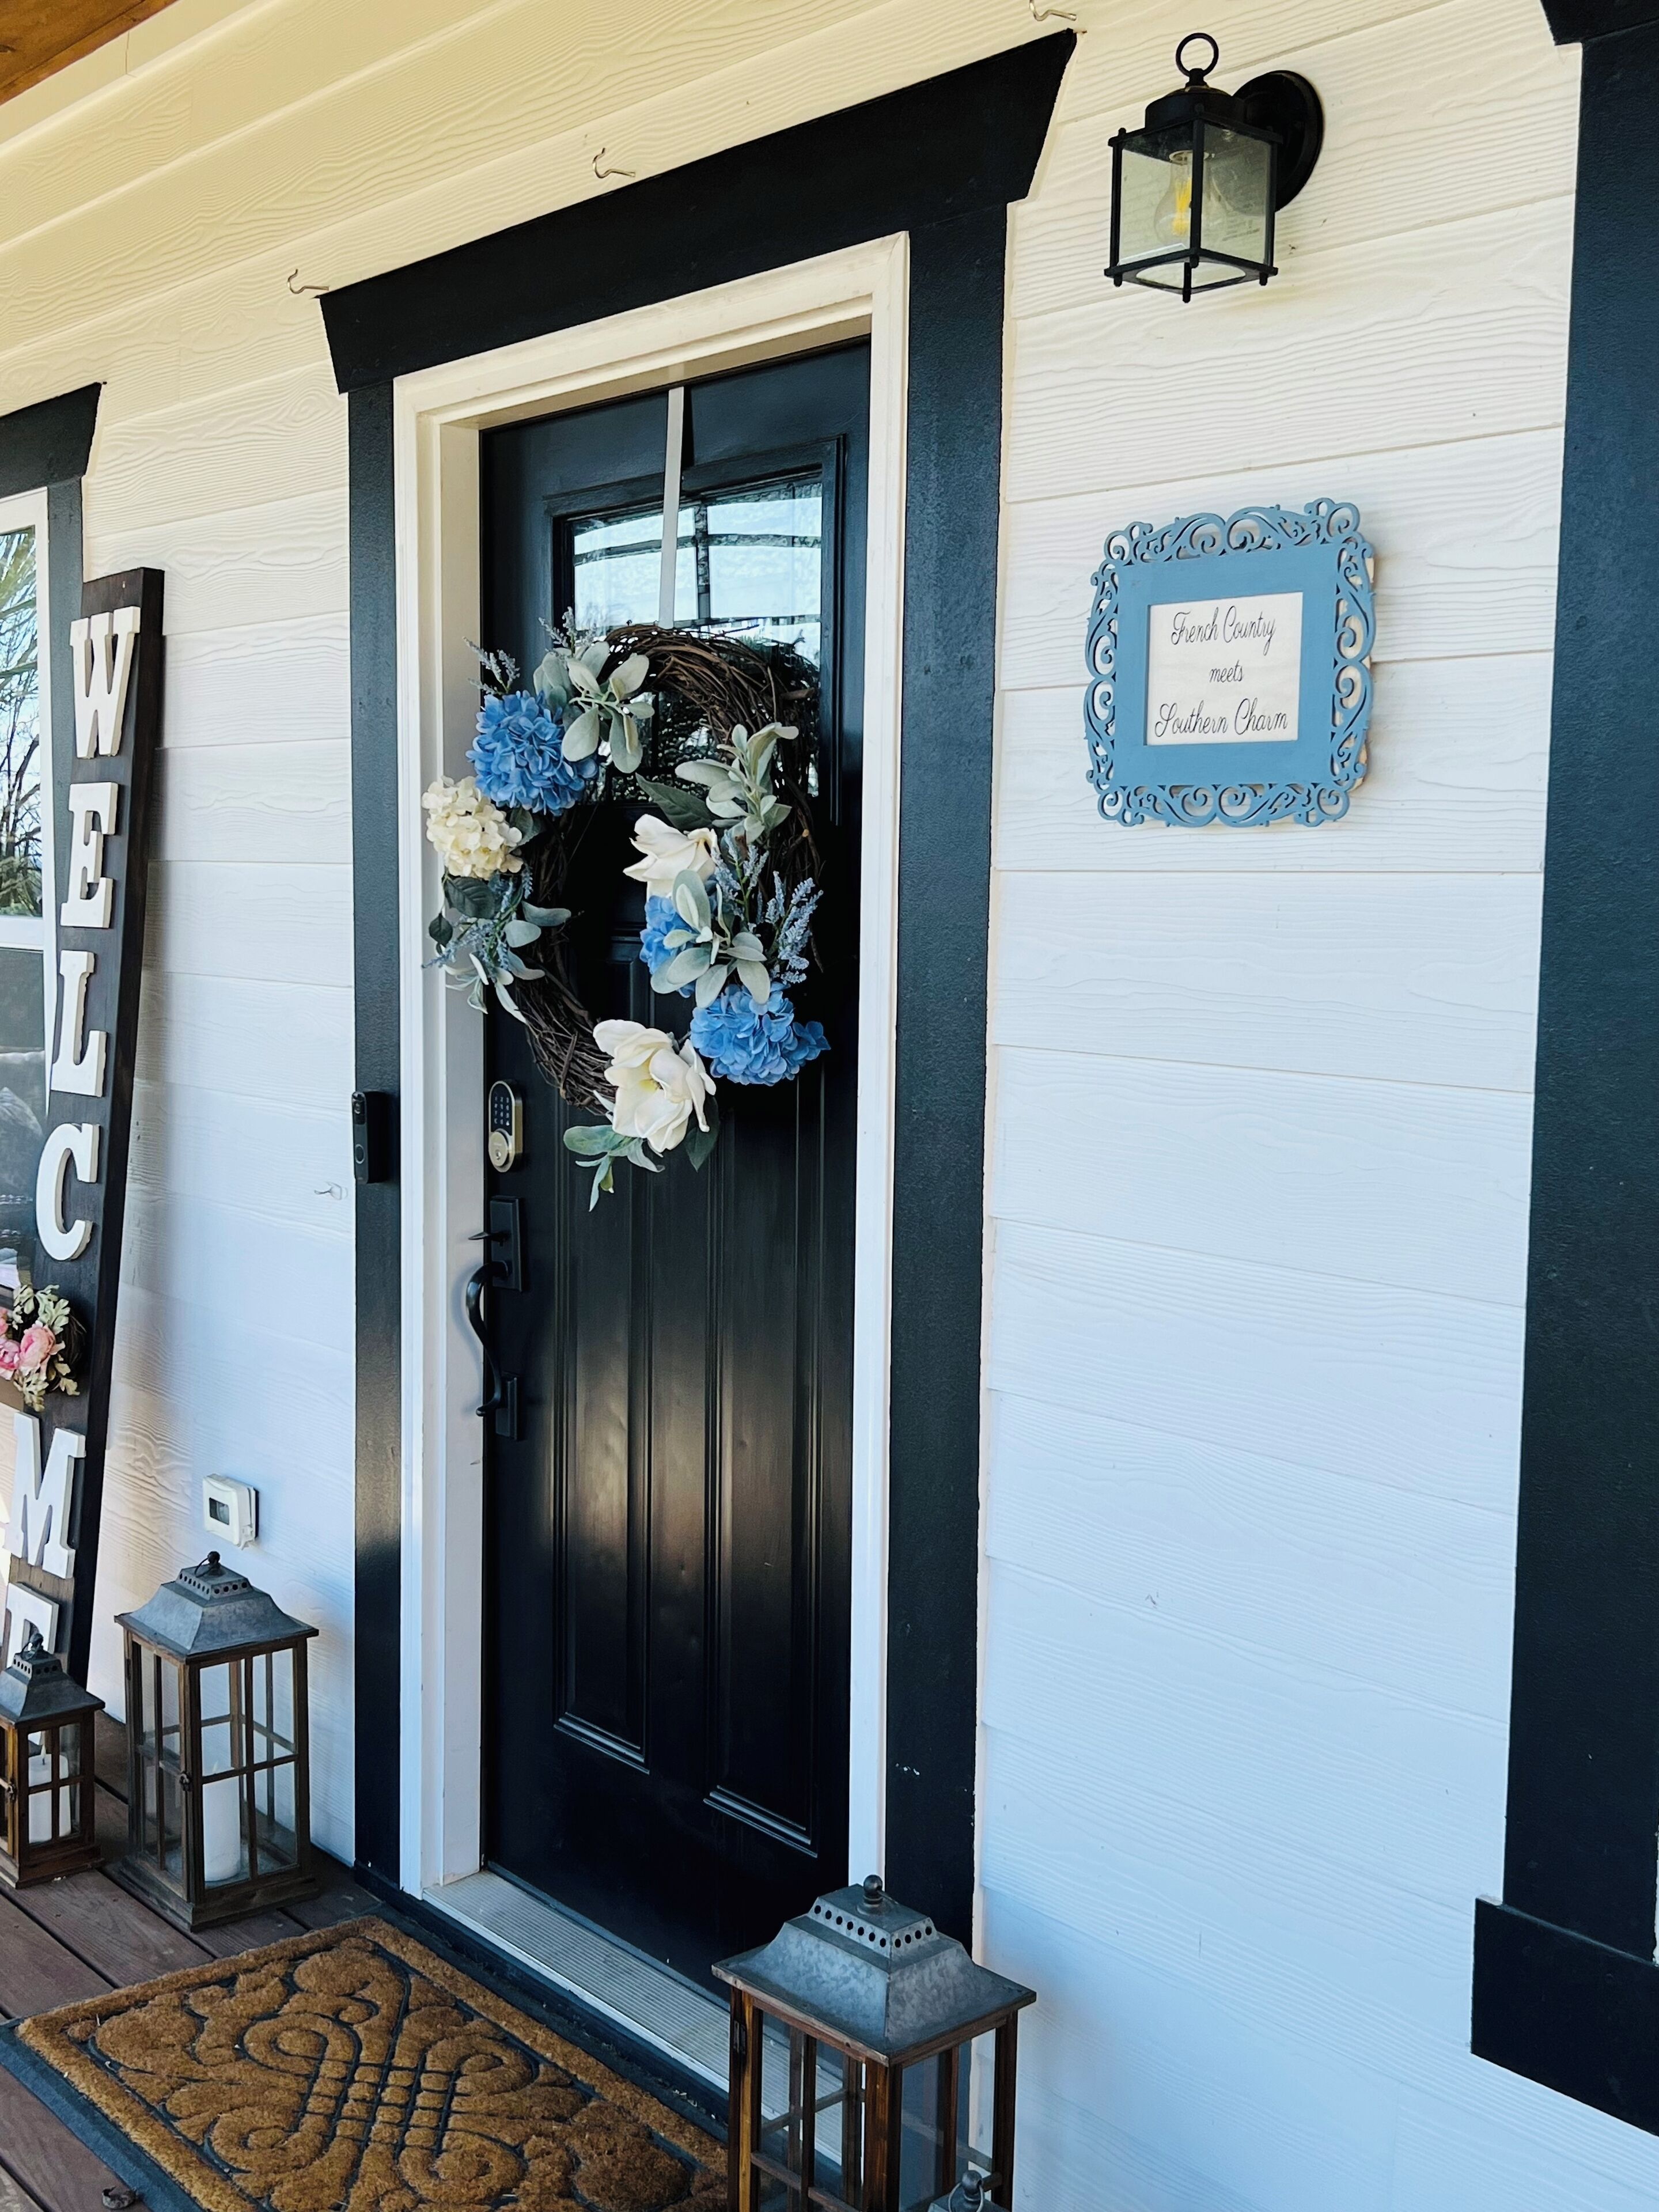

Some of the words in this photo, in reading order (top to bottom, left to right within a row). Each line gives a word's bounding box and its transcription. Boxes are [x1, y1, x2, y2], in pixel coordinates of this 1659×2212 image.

[1171, 607, 1219, 645] French
[1223, 605, 1276, 656] Country
[1209, 660, 1244, 683] meets
[1154, 700, 1229, 737] Southern
[1234, 697, 1288, 735] Charm
